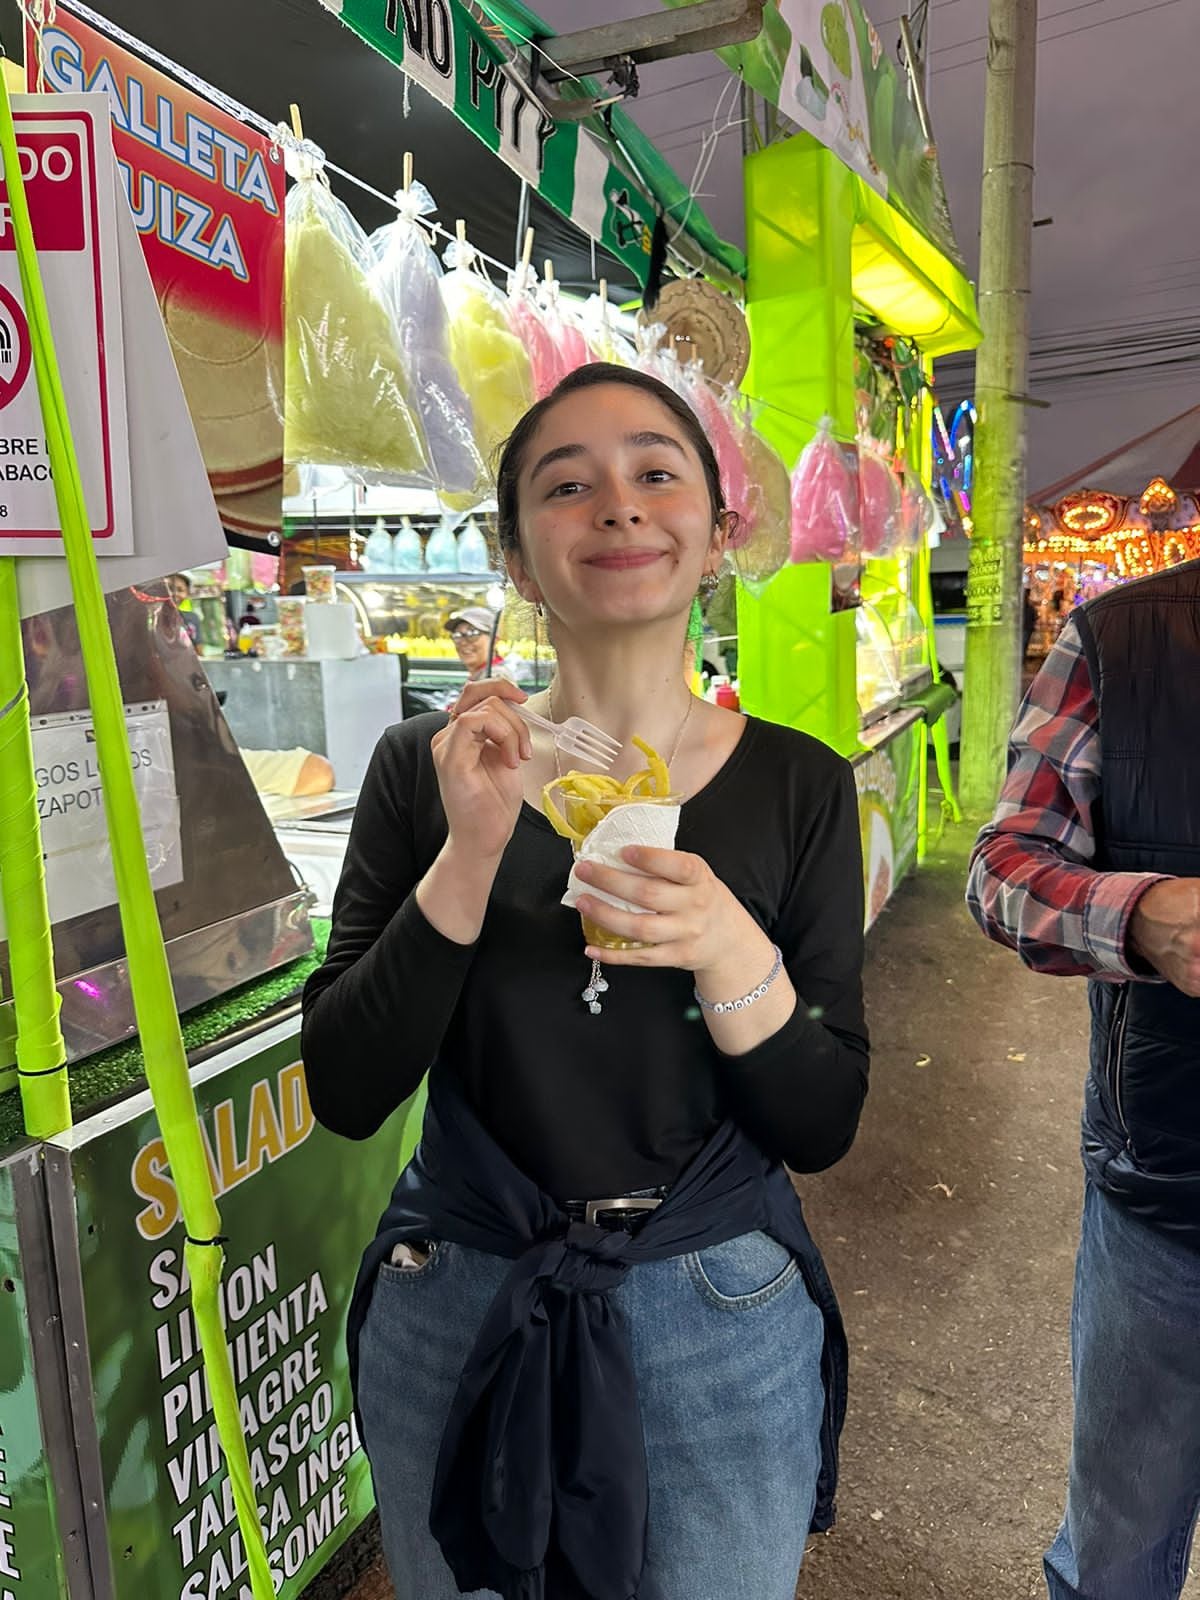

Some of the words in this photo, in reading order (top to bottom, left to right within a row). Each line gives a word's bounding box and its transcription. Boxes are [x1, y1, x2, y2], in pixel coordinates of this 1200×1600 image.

[42, 27, 279, 216] GALLETA
[716, 985, 767, 1012] INDIGO
[131, 1060, 316, 1241] SLAD
[163, 1271, 328, 1446] PIIENTA
